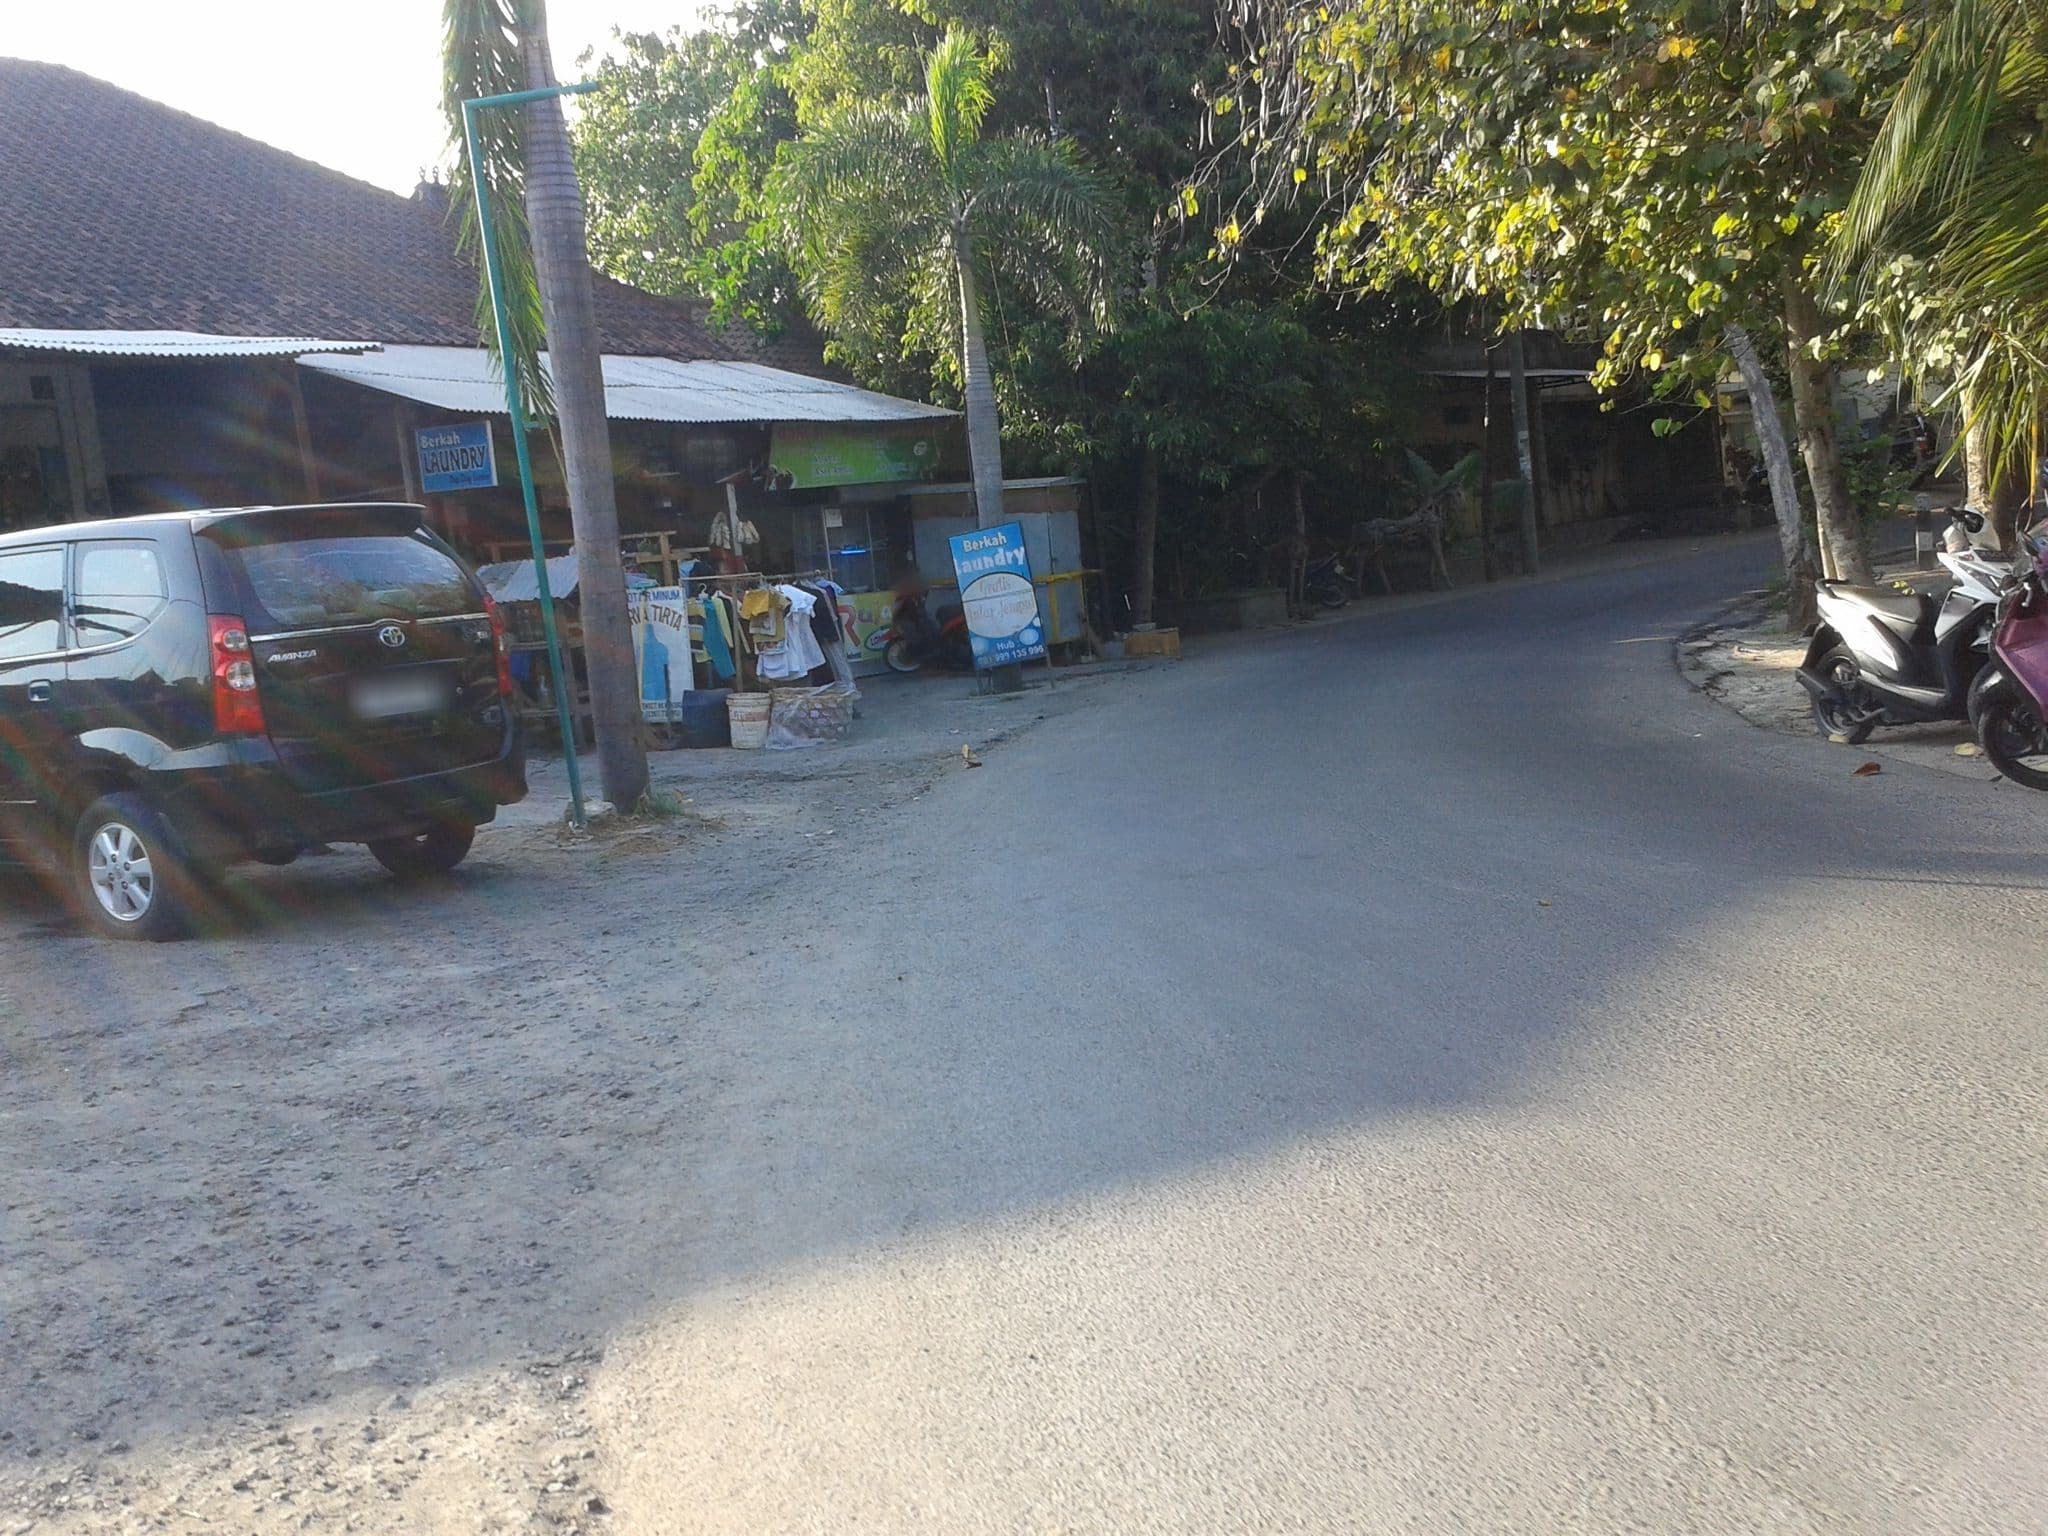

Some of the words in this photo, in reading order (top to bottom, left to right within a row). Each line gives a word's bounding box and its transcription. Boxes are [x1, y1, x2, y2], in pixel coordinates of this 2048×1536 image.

[421, 432, 460, 449] Berkah
[422, 446, 486, 474] LAUNDRY
[962, 532, 1008, 553] Berkah
[653, 590, 680, 601] MINUM
[650, 604, 682, 631] TIRTA
[267, 649, 317, 663] AVANZA
